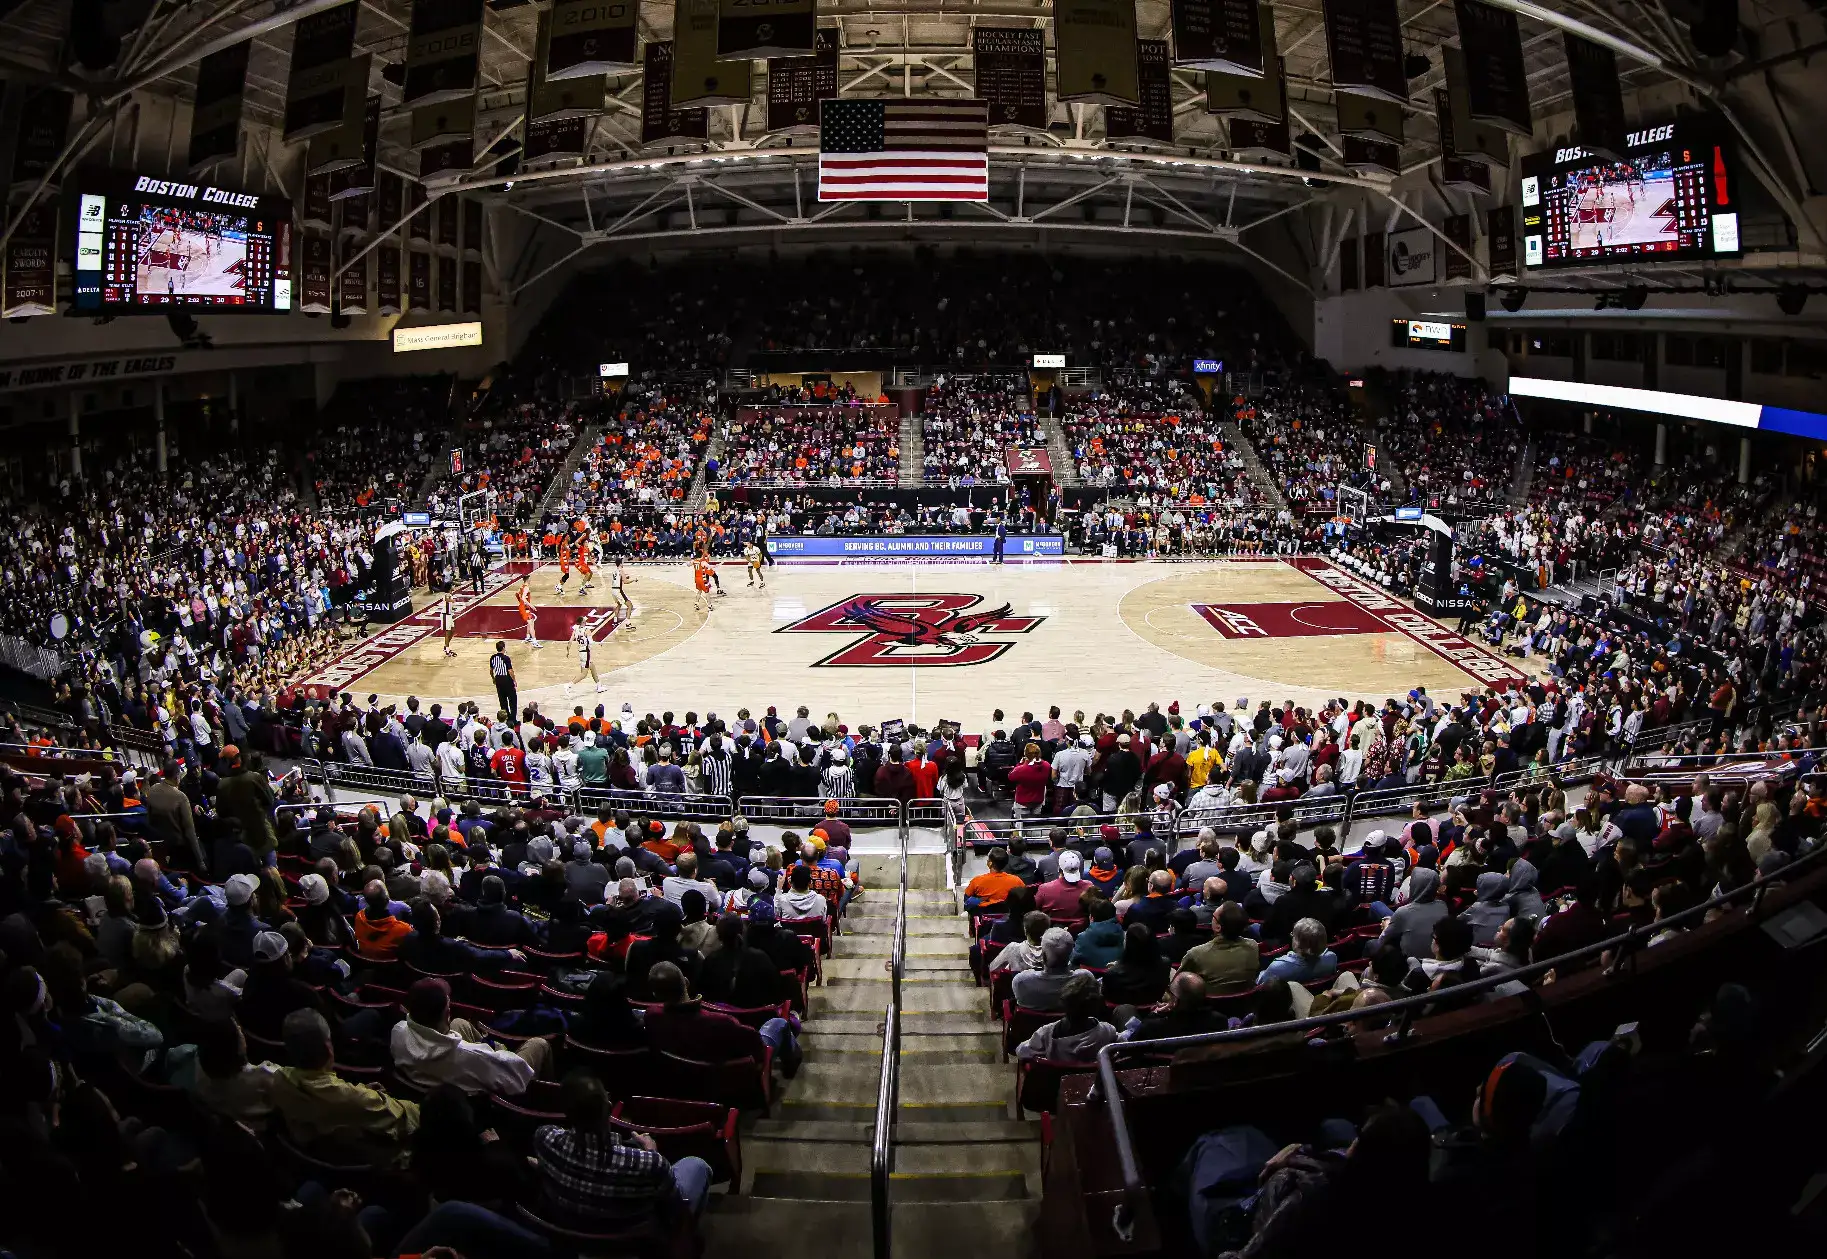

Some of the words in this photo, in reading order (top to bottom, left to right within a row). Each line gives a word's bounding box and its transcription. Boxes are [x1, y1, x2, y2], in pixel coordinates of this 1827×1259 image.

[564, 4, 625, 25] 2010
[978, 31, 1017, 39] HOCKEY
[978, 45, 1041, 53] CHAMPIONS
[1683, 150, 1691, 162] S
[134, 175, 197, 200] BOSTON
[202, 187, 260, 209] COLLEGE
[12, 247, 49, 258] CAROLYN
[14, 258, 46, 270] SWORDS
[15, 289, 45, 298] 2007-11
[19, 366, 65, 386] HOME
[67, 364, 88, 380] OF
[92, 361, 120, 378] THE
[124, 356, 177, 374] EAGLES
[1196, 360, 1221, 372] xfinity
[844, 542, 874, 551] SERVING
[888, 542, 914, 551] ALUMNI
[915, 542, 929, 550] AND
[930, 542, 951, 550] THEIR
[951, 542, 983, 550] FAMILIES
[393, 596, 411, 610] GEICO
[1416, 591, 1434, 606] GEICO
[1436, 599, 1474, 608] NISSA
[1213, 607, 1269, 636] ACC
[1304, 567, 1406, 610] BOSTON
[1384, 613, 1526, 684] COLLEGE
[577, 635, 585, 645] 45
[302, 624, 435, 688] BOSTON
[681, 743, 694, 754] 10
[505, 761, 516, 774] 6
[531, 769, 541, 781] 2
